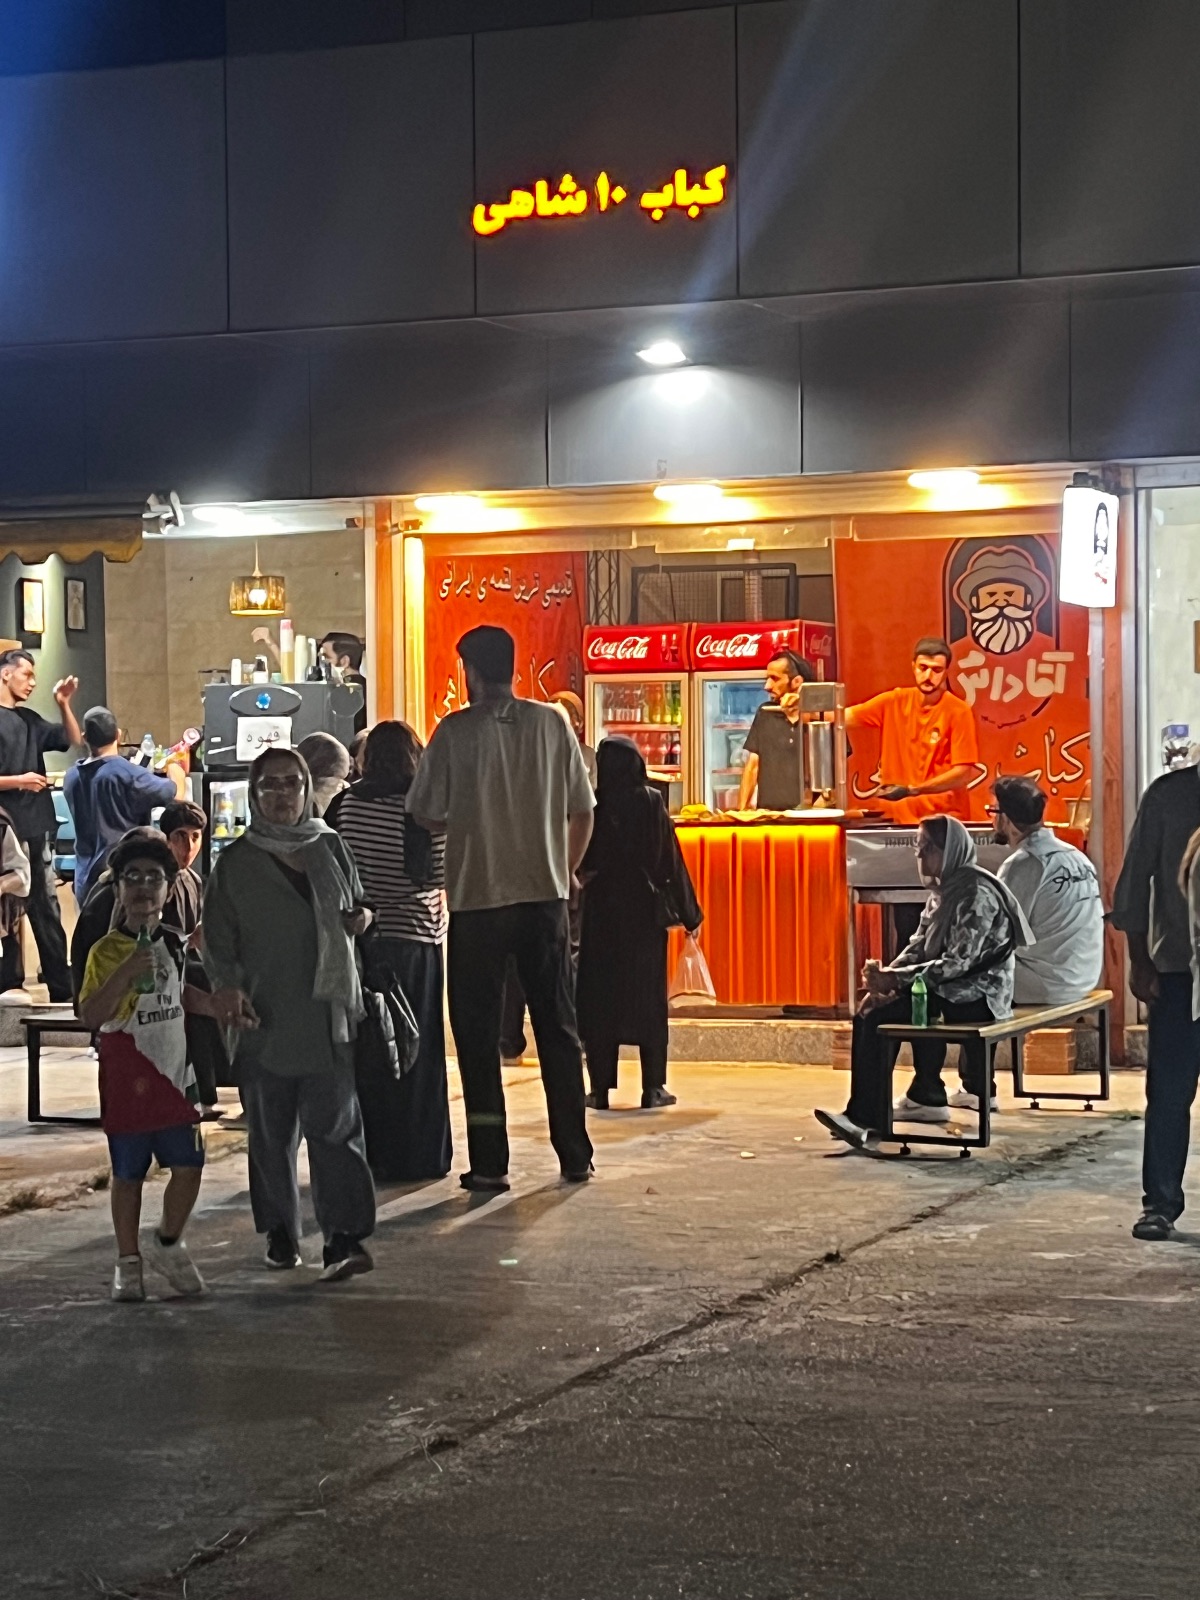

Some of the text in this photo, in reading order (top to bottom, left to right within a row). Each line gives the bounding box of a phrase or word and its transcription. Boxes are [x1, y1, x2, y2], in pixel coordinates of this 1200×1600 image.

[472, 164, 727, 235] کباب ۱۰ شاهی
[439, 560, 474, 599] ایرانی
[1026, 651, 1075, 698] آقا
[246, 726, 280, 749] قهوه
